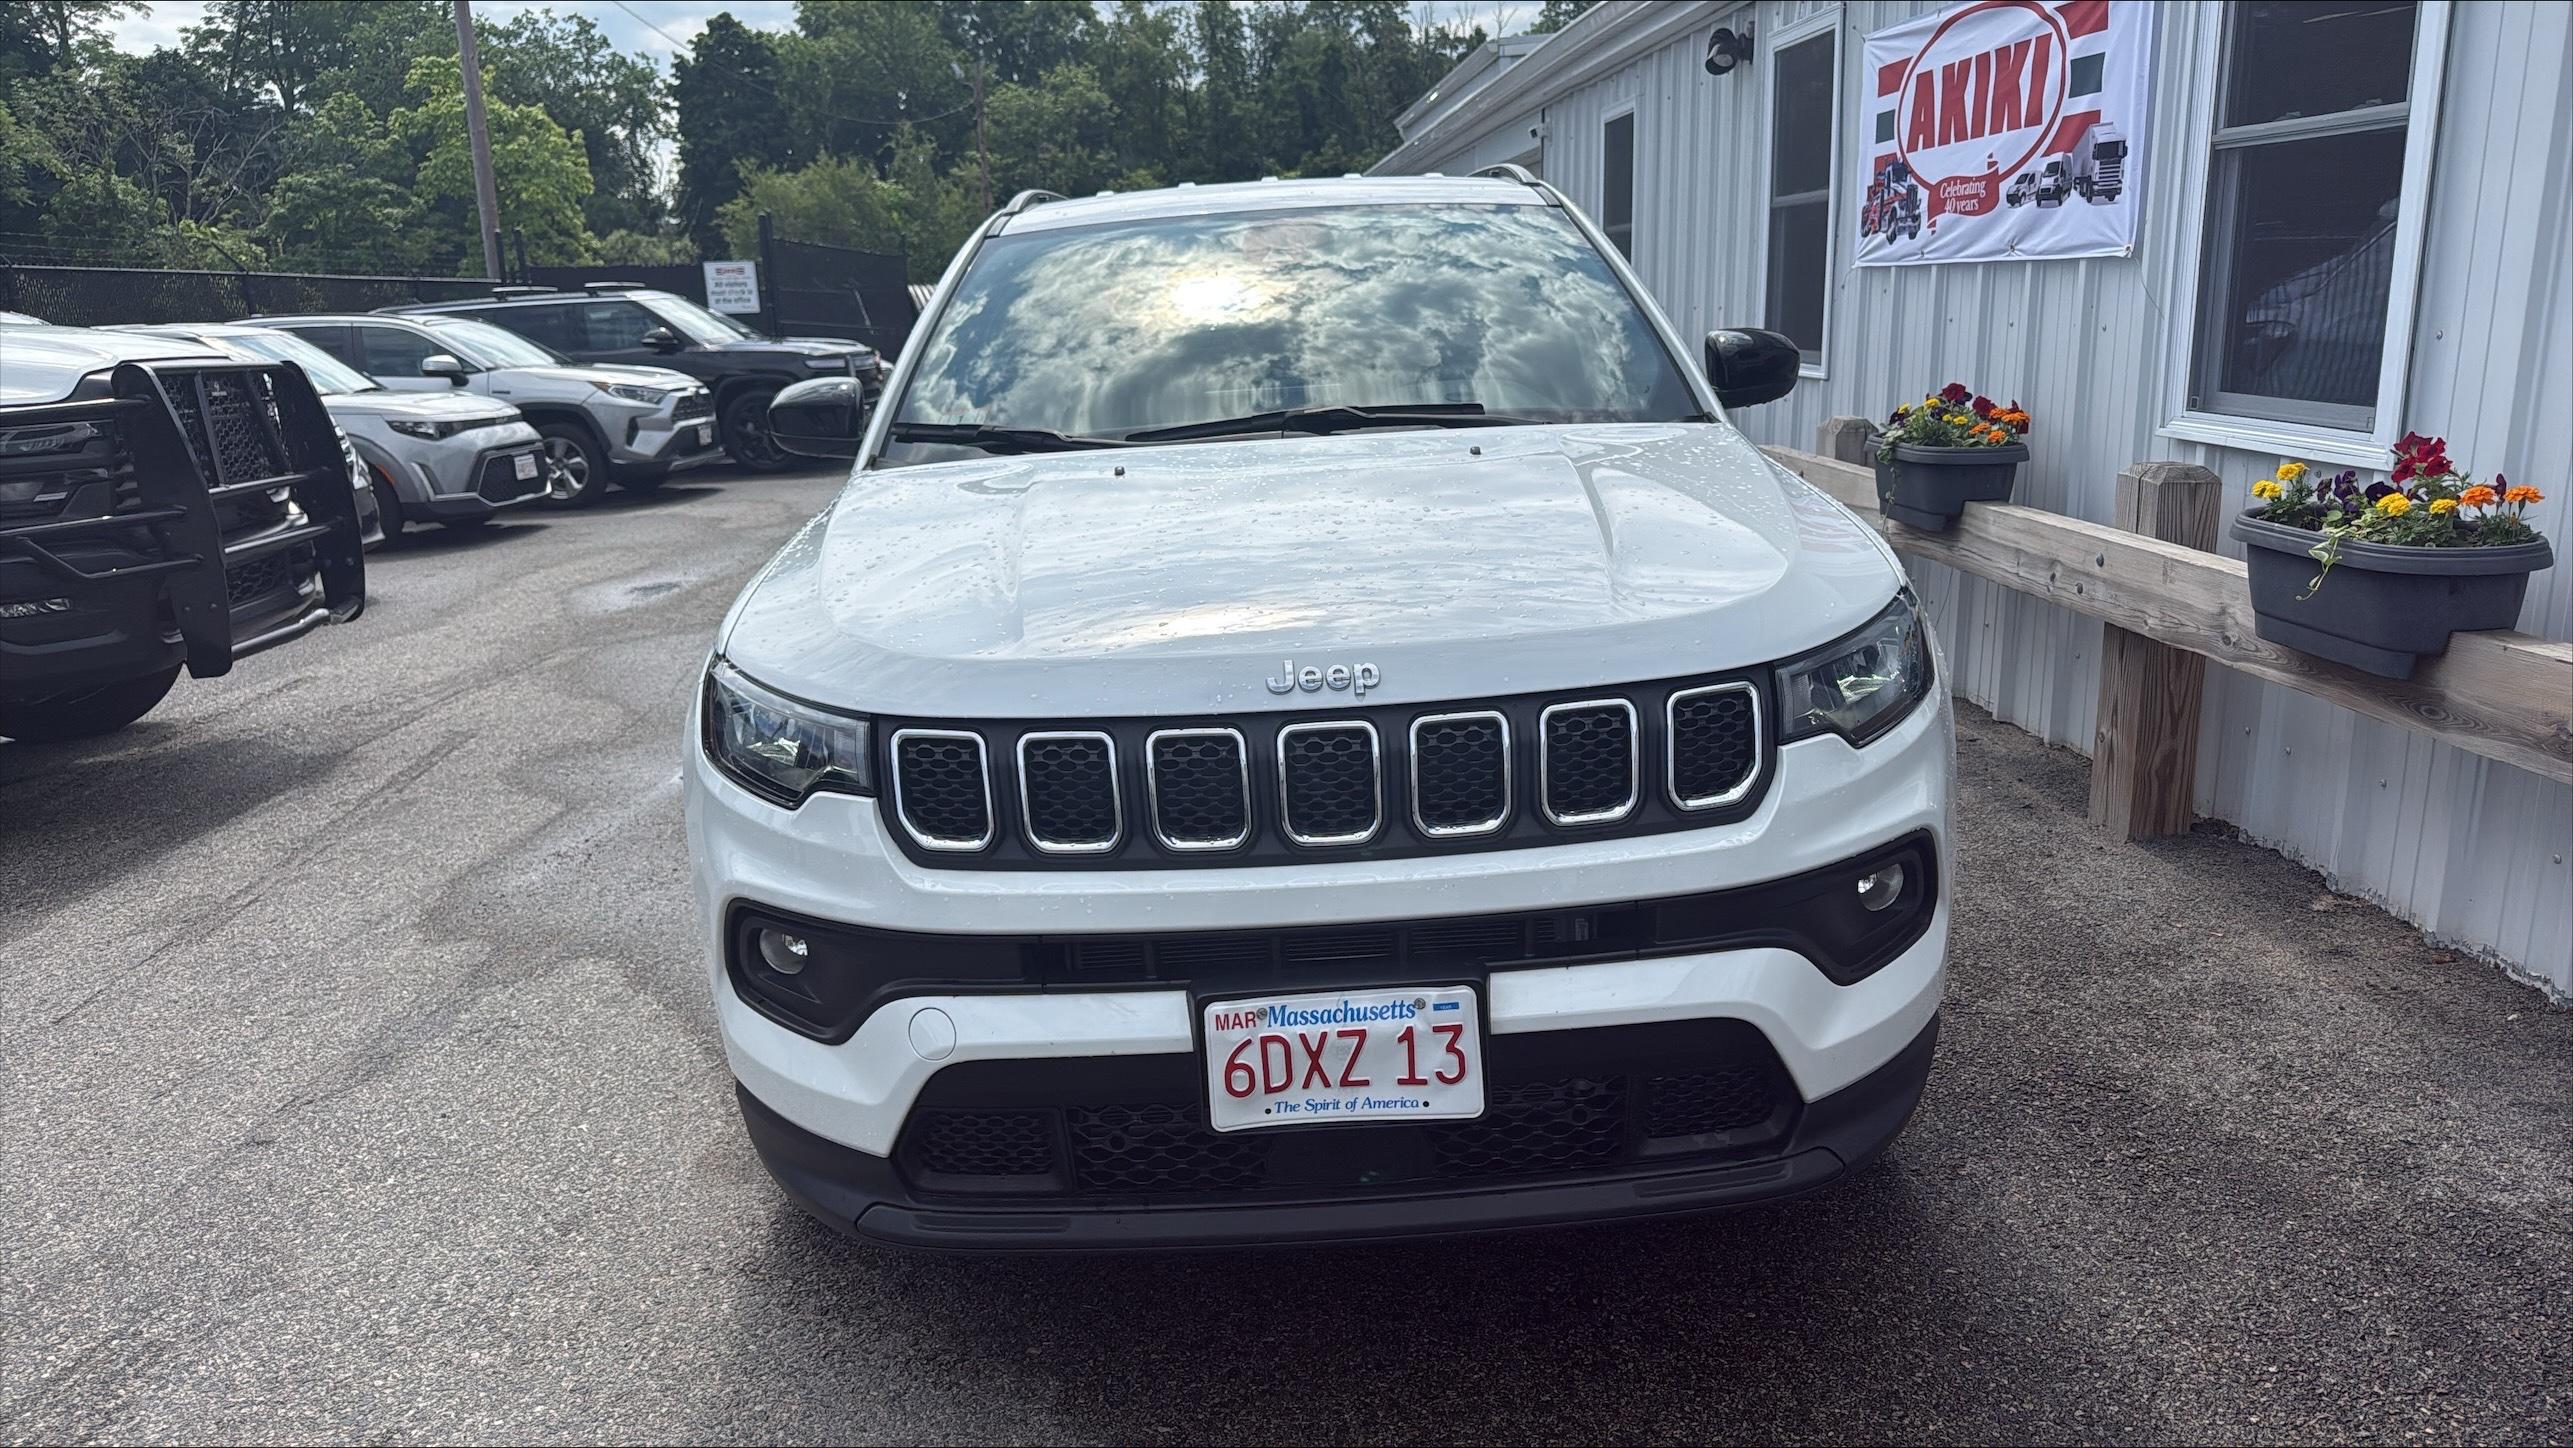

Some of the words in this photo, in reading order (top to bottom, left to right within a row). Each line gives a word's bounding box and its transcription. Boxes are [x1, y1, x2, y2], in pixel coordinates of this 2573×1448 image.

[1906, 32, 2053, 154] AKIKI
[1940, 178, 1987, 198] Celebrating
[1945, 198, 1956, 213] 40
[1956, 198, 1979, 214] years
[1266, 659, 1381, 696] Jeep
[1214, 1011, 1256, 1031] MAR
[1266, 1000, 1416, 1028] Massachusetts
[1223, 1028, 1371, 1098] 6DXZ
[1396, 1023, 1467, 1086] 13
[1274, 1101, 1300, 1114] The
[1304, 1098, 1340, 1114] Spirit
[1345, 1097, 1358, 1112] of
[1361, 1097, 1419, 1110] America
